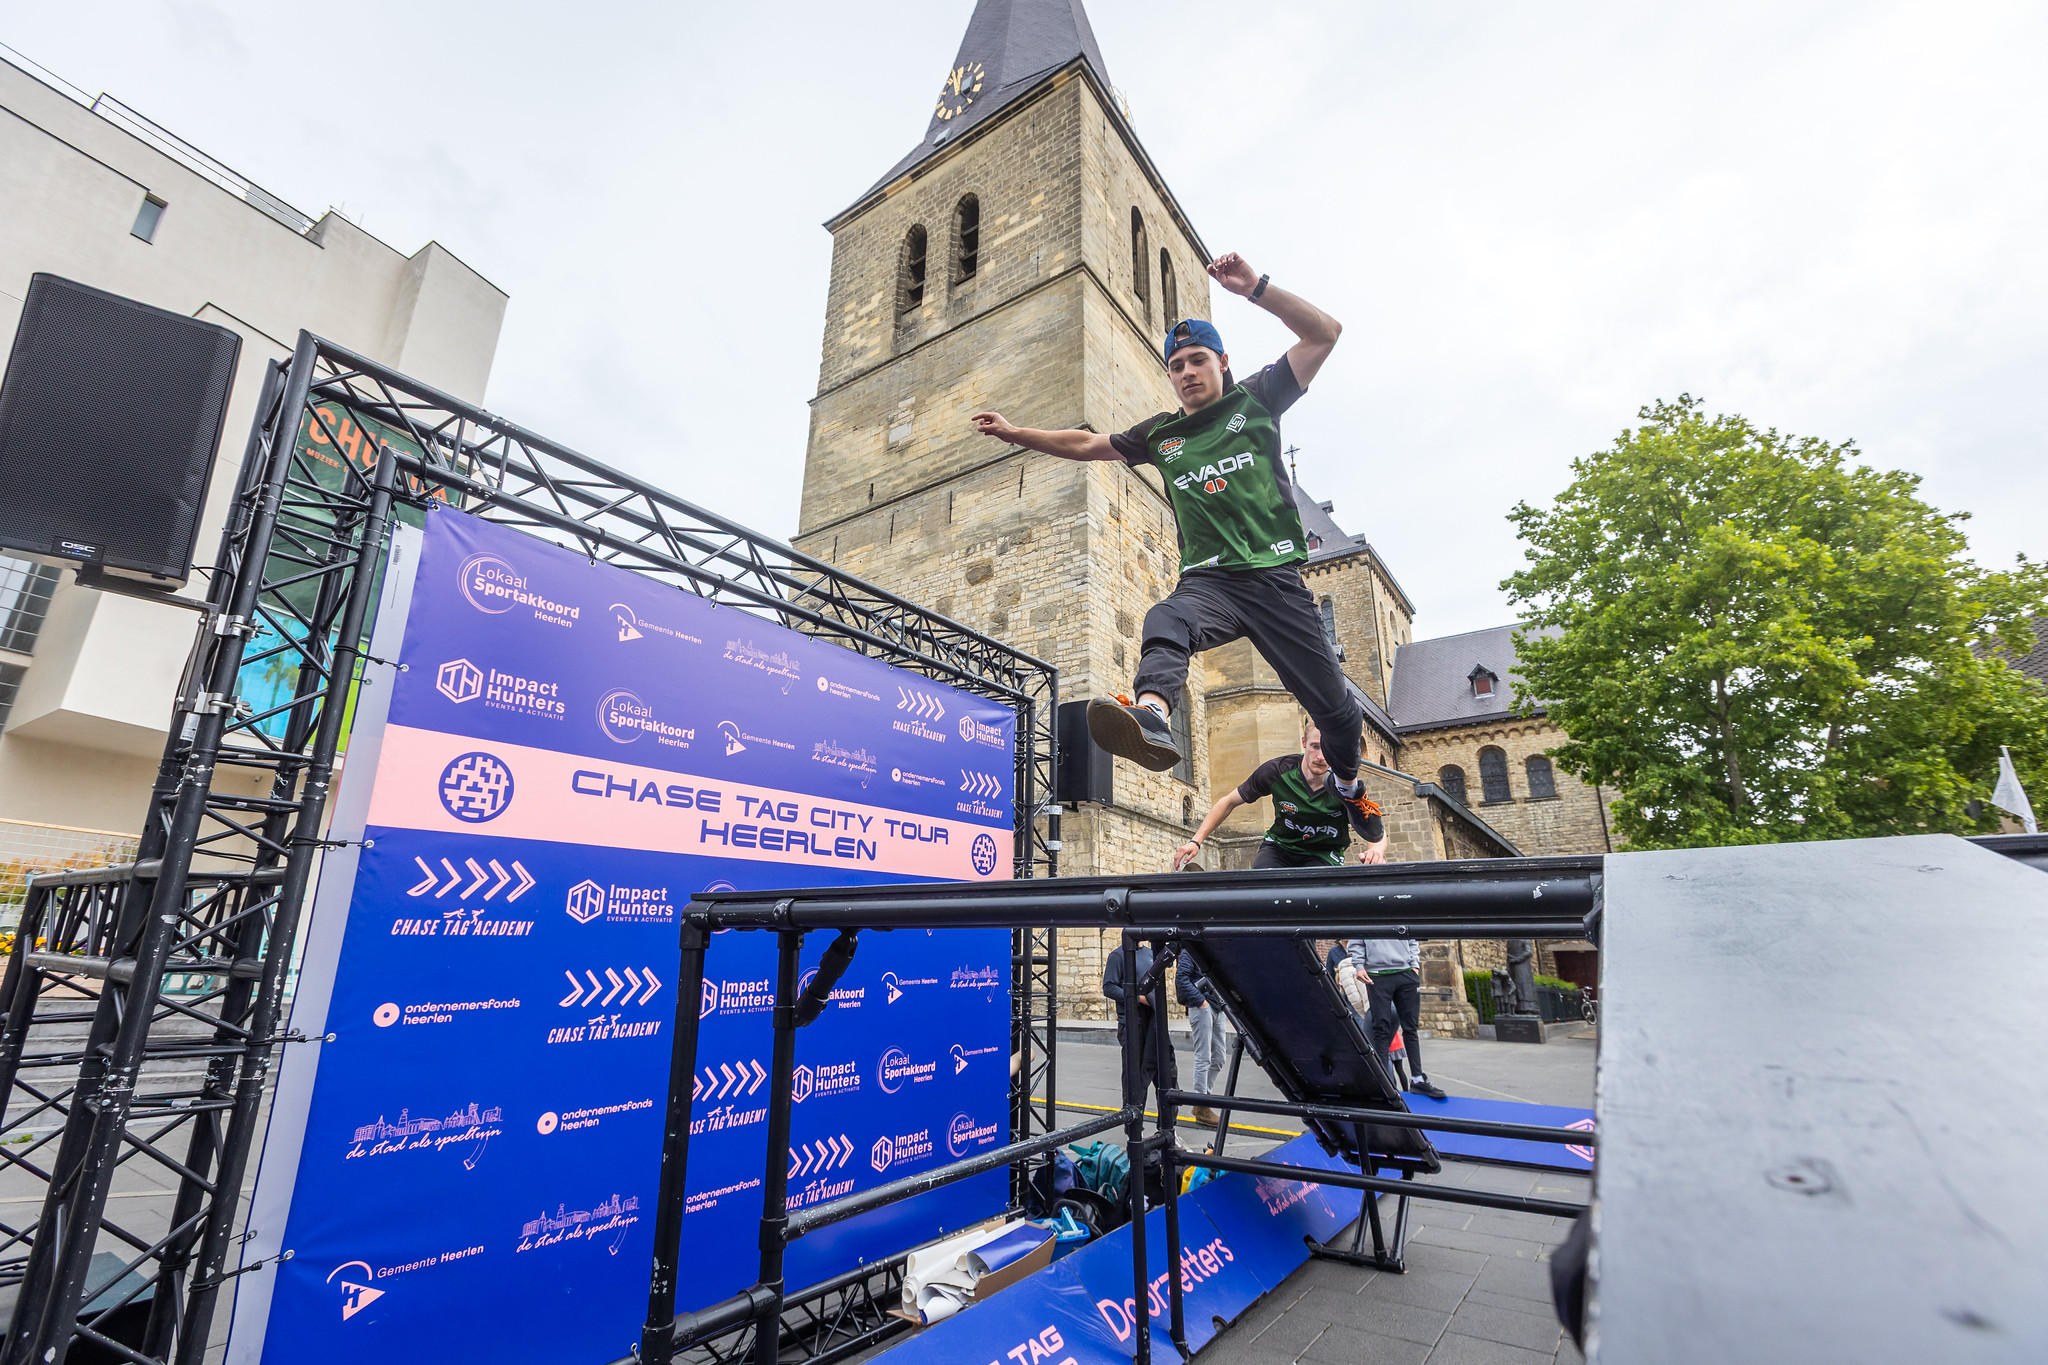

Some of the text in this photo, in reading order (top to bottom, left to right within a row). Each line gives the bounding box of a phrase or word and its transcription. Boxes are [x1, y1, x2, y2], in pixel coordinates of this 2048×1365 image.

[62, 542, 96, 552] QSC
[1270, 539, 1294, 556] 19
[476, 562, 527, 590] Lokaal
[474, 577, 580, 620] Sportakkoord
[534, 611, 573, 629] Heerlen
[638, 619, 702, 645] Gemeente Heerlen
[723, 650, 733, 660] de
[735, 655, 753, 666] stad
[489, 668, 558, 697] Impact
[486, 684, 566, 714] Hunters
[830, 682, 880, 702] ondernemersfonds
[830, 688, 851, 699] heerlen
[485, 701, 516, 712] EVENTS
[526, 708, 564, 721] ACTIVATIE
[611, 697, 652, 718] Lokaal
[610, 712, 695, 740] Sportakkoord
[893, 720, 946, 743] CHASE TAG ACADEMY
[976, 720, 1002, 736] Impact
[658, 736, 690, 750] Heerlen
[742, 732, 795, 750] Gemeente Heerlen
[976, 730, 1005, 746] Hunters
[902, 772, 946, 786] ondernemersfonds
[902, 778, 920, 786] heerlen
[572, 770, 949, 845] CHASE TAG CITY TOUR
[956, 802, 1003, 818] CHASE TAG ACADEMY
[700, 819, 876, 863] HEERLEN
[610, 884, 668, 902] Impact
[607, 898, 674, 917] Hunters
[391, 919, 534, 936] CHASE TAG ACADEMY
[640, 916, 673, 924] ACTIVATIE
[721, 978, 770, 996] Impact
[829, 987, 865, 1000] akkoord
[404, 998, 520, 1014] ondernemersfonds
[720, 994, 775, 1008] Hunters
[838, 1000, 861, 1009] Heerlen
[402, 1012, 452, 1026] heerlen
[547, 1021, 661, 1044] CHASE TAG ACADEMY
[816, 1060, 856, 1078] Impact
[885, 1054, 910, 1067] Lokaal
[884, 1061, 936, 1080] Sportakkoord
[914, 1074, 933, 1083] Heerlen
[815, 1075, 860, 1091] Hunters
[562, 1099, 653, 1120] ondernemersfonds
[560, 1116, 600, 1132] heerlen
[690, 1108, 767, 1135] ASE TAG ACADEMY
[954, 1118, 975, 1132] Lokaal
[346, 1125, 502, 1160] de stad als speeltuin
[895, 1128, 928, 1147] Impact
[953, 1123, 997, 1145] Sportakkoord
[978, 1136, 995, 1145] Heerlen
[894, 1141, 933, 1160] Hunters
[686, 1178, 760, 1204] ondernemersfonds
[786, 1179, 854, 1210] HASE TAG ACADEMY
[685, 1200, 717, 1214] heerlen
[516, 1214, 639, 1253] de stad als speeltuin
[377, 1245, 484, 1279] Gemeente Heerlen
[1006, 1324, 1064, 1365] TAG
